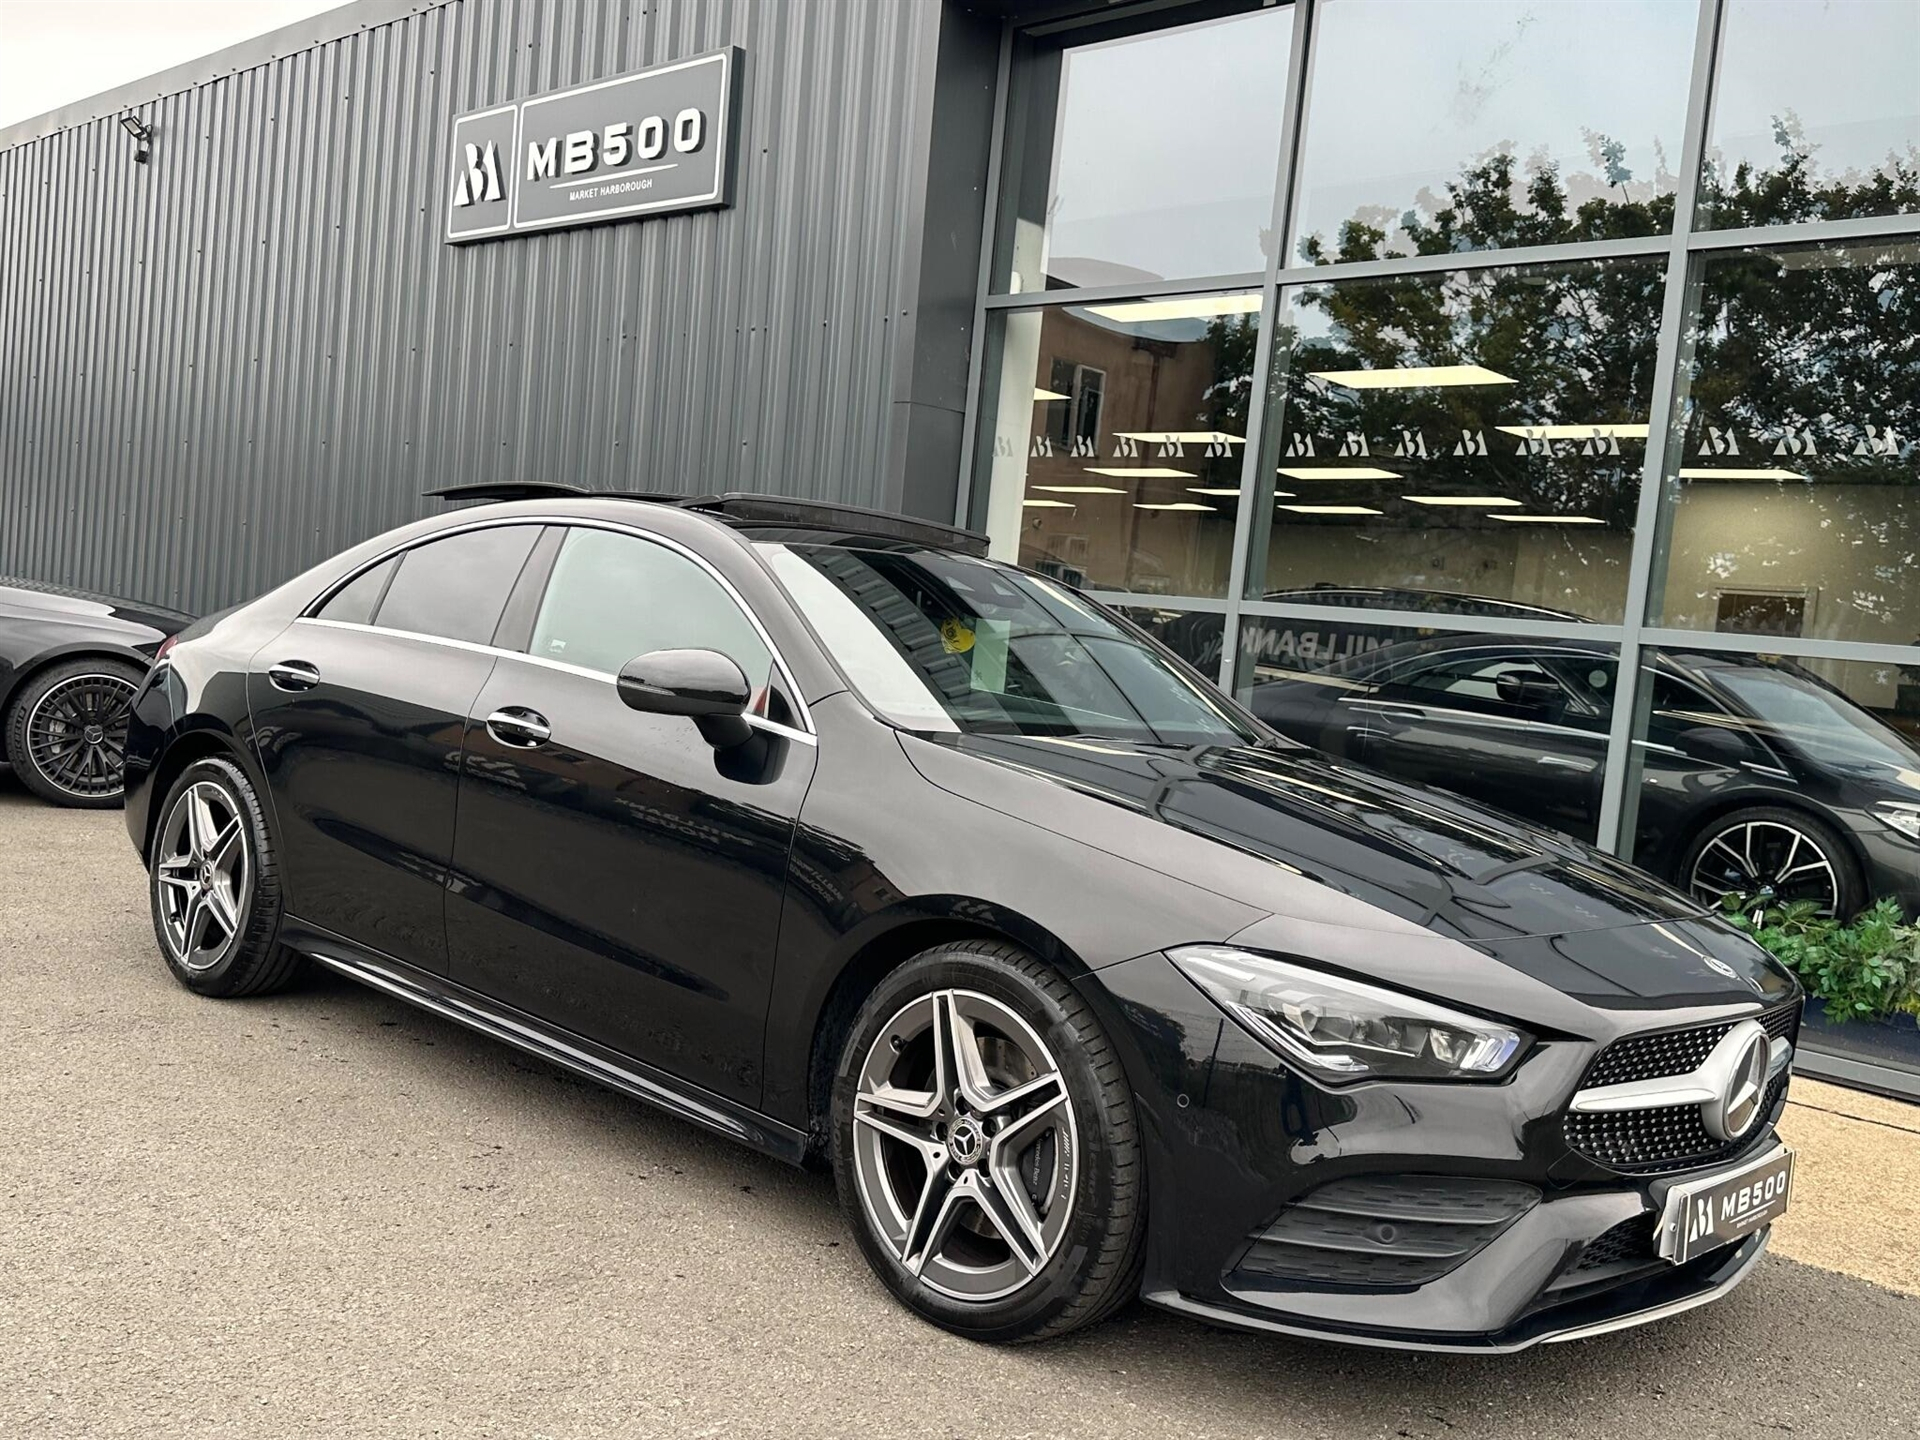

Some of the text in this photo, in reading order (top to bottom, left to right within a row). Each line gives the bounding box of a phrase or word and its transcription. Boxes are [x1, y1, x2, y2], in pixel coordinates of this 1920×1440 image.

[527, 107, 704, 182] MB500
[569, 178, 653, 201] MARKET HARBOROUGH
[1721, 1170, 1786, 1221] MB500
